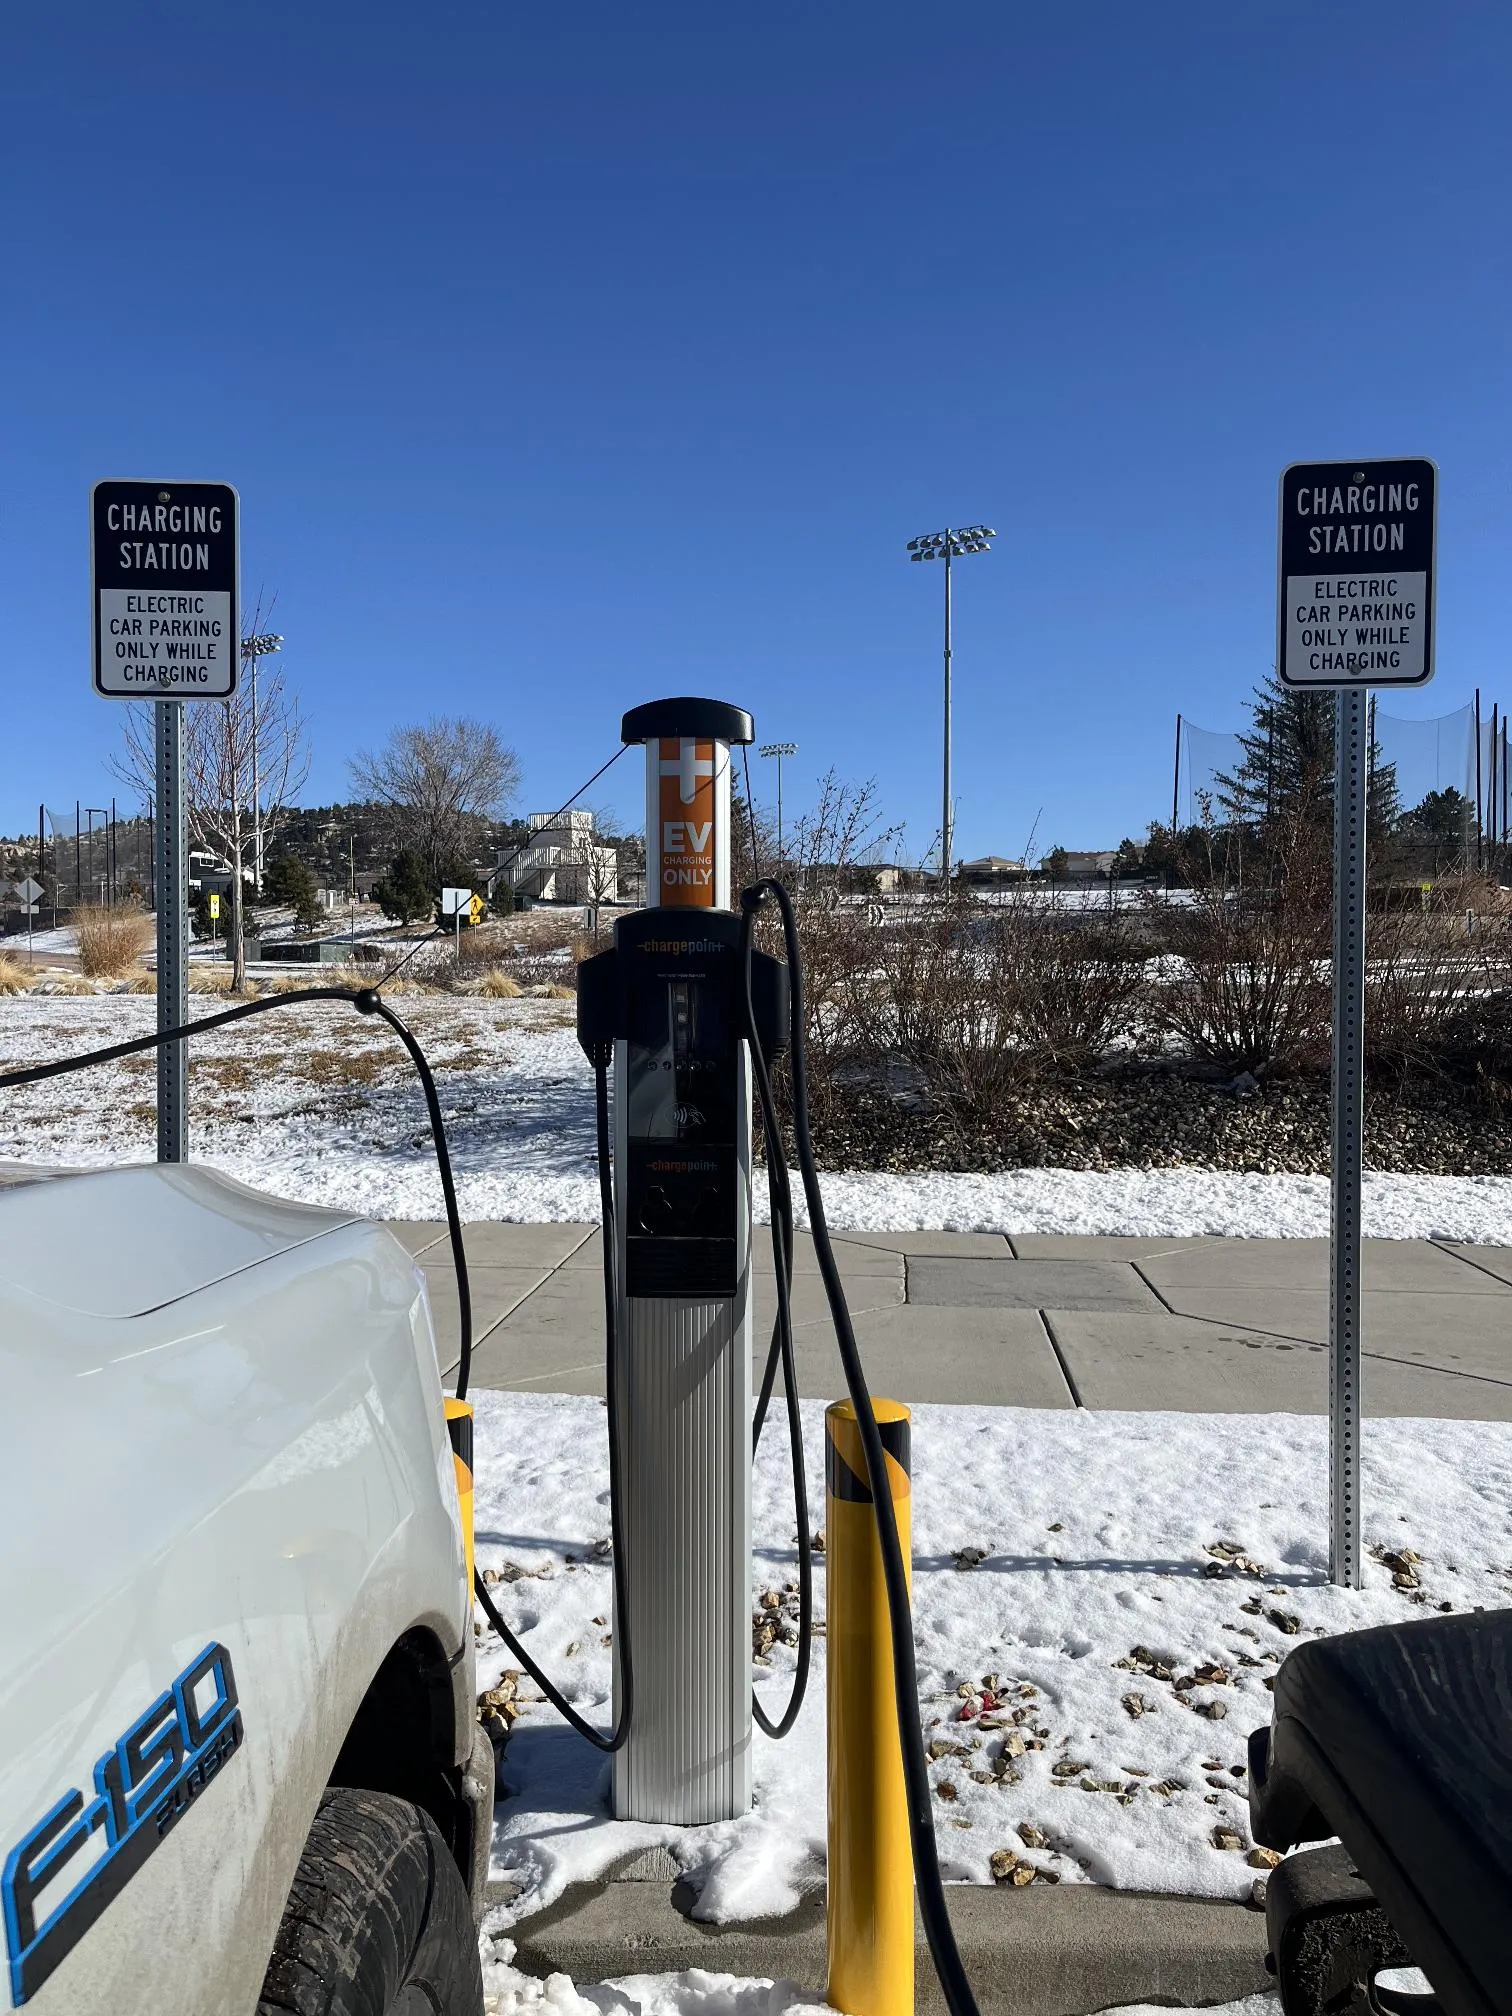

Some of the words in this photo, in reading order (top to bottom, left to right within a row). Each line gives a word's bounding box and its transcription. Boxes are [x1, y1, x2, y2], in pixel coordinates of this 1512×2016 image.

[1297, 483, 1419, 516] CHARGING
[107, 503, 222, 533] CHARGING
[1308, 523, 1404, 554] STATION
[120, 541, 209, 571] STATION
[1315, 579, 1398, 599] ELECTRIC
[127, 595, 204, 614] ELECTRIC
[1296, 605, 1331, 623] CAR
[1338, 602, 1416, 622] PARKING
[110, 618, 142, 636] CAR
[150, 620, 222, 637] PARKING
[1301, 628, 1348, 647] ONLY
[1356, 626, 1410, 645] WHILE
[115, 642, 160, 659] ONLY
[166, 643, 217, 660] WHILE
[1309, 651, 1400, 671] CHARGING
[123, 665, 208, 683] CHARGING
[663, 822, 712, 853] EV
[663, 856, 712, 865] CHARGING
[663, 868, 712, 885] ONLY
[155, 1722, 240, 1837] FLASH
[1, 1640, 240, 1963] F-150
